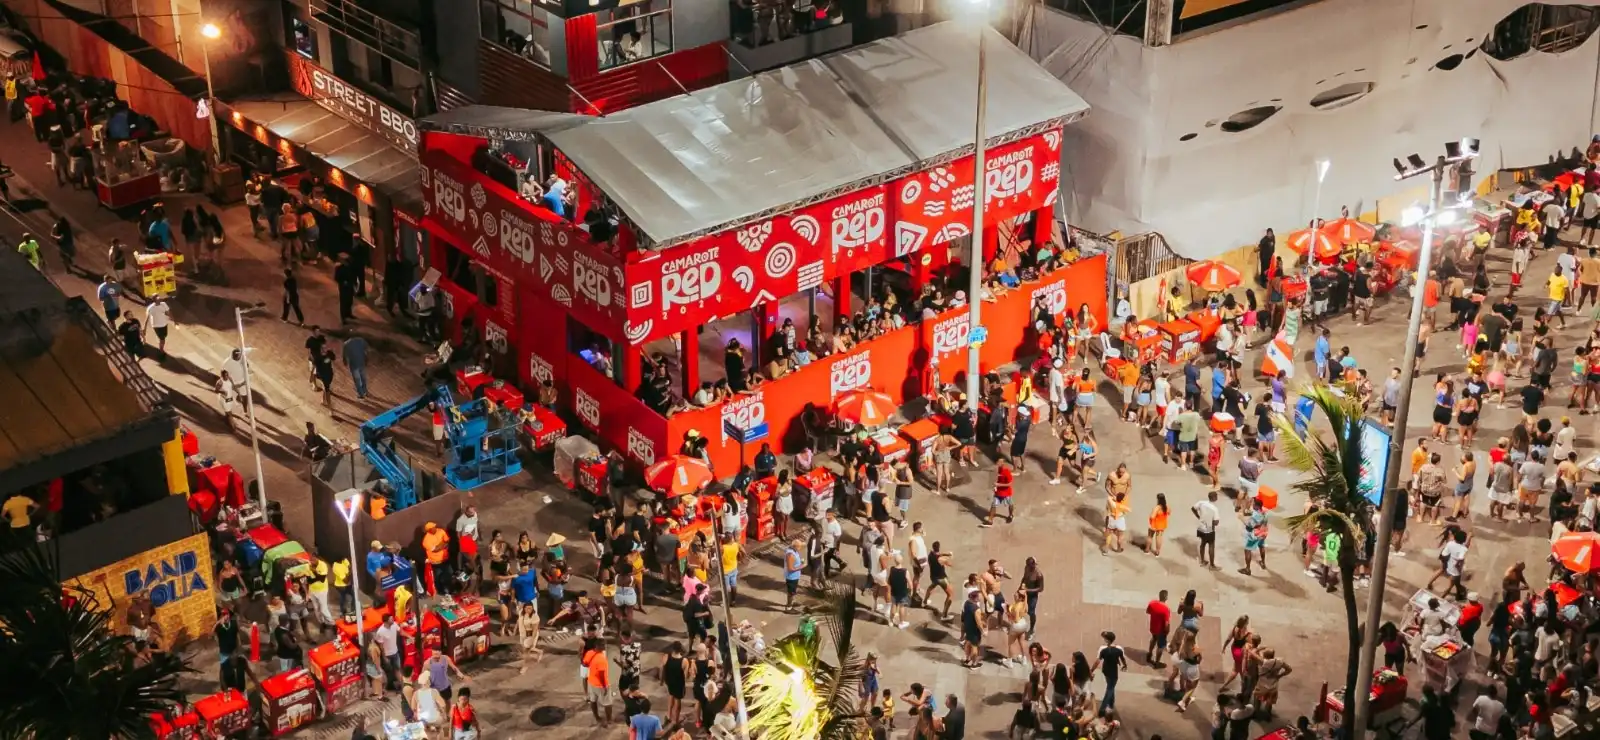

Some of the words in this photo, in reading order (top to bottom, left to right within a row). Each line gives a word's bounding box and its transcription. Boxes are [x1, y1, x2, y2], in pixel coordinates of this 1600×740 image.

[312, 70, 377, 117] STREET
[379, 105, 417, 144] BBQ
[986, 145, 1034, 170] CAMAROTE
[832, 193, 884, 219] CAMAROTE
[661, 247, 720, 274] CAMAROTE
[124, 551, 198, 595] BAND
